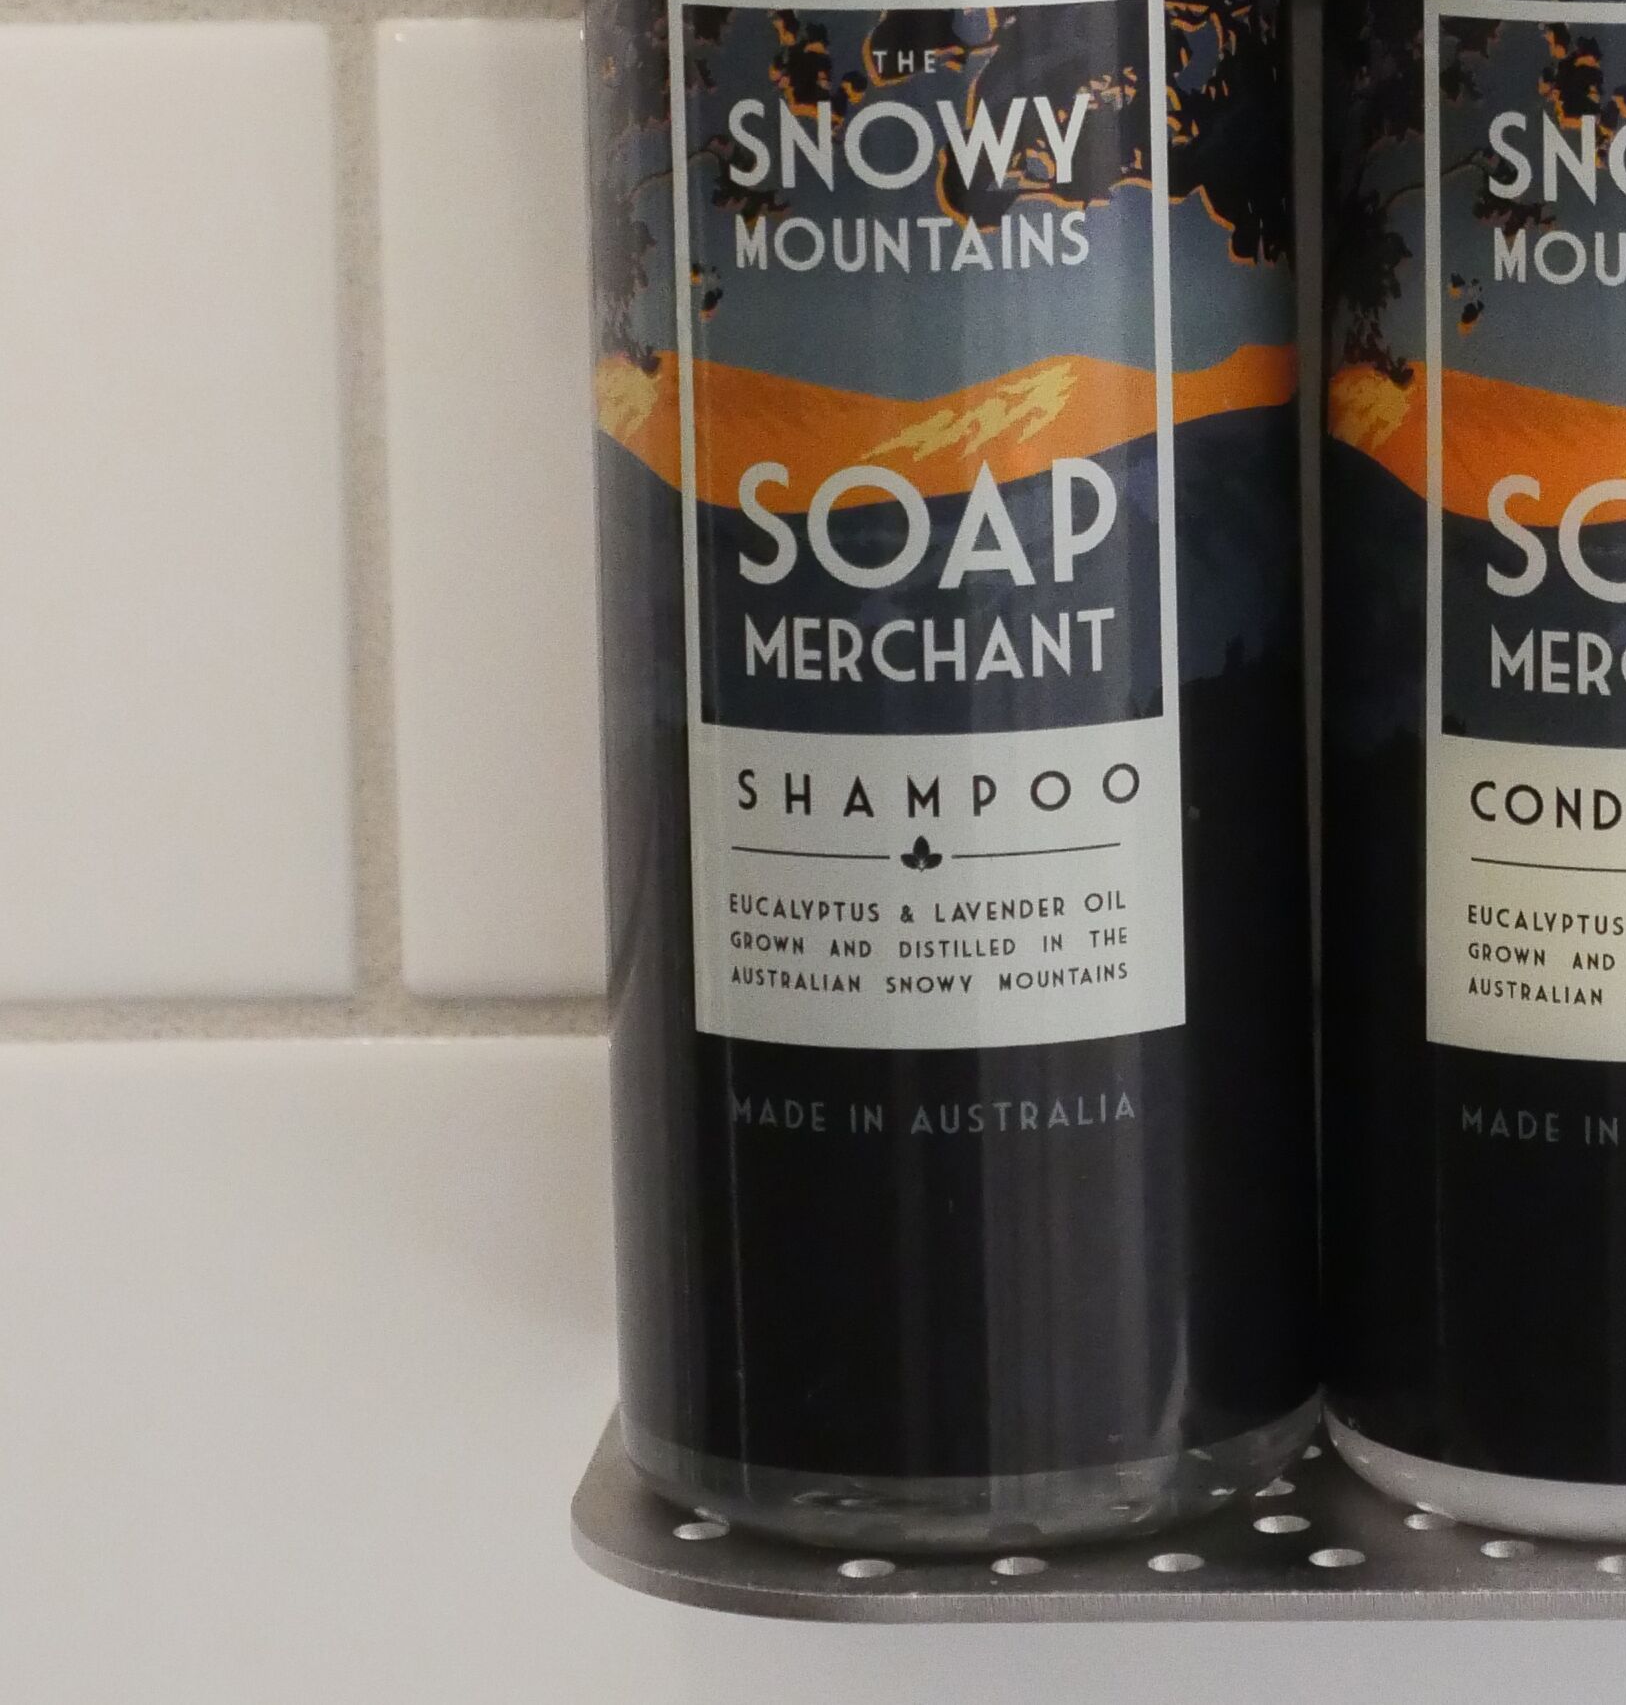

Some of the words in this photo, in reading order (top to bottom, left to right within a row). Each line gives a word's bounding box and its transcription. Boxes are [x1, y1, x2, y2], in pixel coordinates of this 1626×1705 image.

[871, 50, 937, 75] THE
[727, 91, 1094, 193] SNOWY
[734, 208, 1091, 274] MOUNTAINS
[737, 456, 1118, 590] SOAP
[744, 607, 1116, 683] MERCHANT
[737, 761, 1141, 819] SHAMPOO
[728, 892, 881, 924] EUCALYPTUS
[899, 904, 915, 924] &
[934, 895, 1066, 924] LAVENDER
[1083, 889, 1127, 914] OIL
[1466, 903, 1625, 937] EUCALYPTUS
[729, 930, 805, 957] GROWN
[828, 939, 873, 959] AND
[899, 938, 1017, 959] DISTILLED
[1042, 934, 1064, 954] IN
[1088, 926, 1129, 949] THE
[1467, 942, 1547, 968] GROWN
[1571, 951, 1616, 971] AND
[730, 966, 862, 994] AUSTRALIAN
[885, 973, 974, 995] SNOWY
[998, 962, 1129, 992] MOUNTAINS
[1467, 976, 1604, 1007] AUSTRALIAN
[729, 1095, 827, 1133] MADE
[849, 1102, 884, 1134] IN
[909, 1091, 1137, 1136] AUSTRALIA
[1461, 1103, 1560, 1143] MADE
[1584, 1116, 1619, 1146] IN
